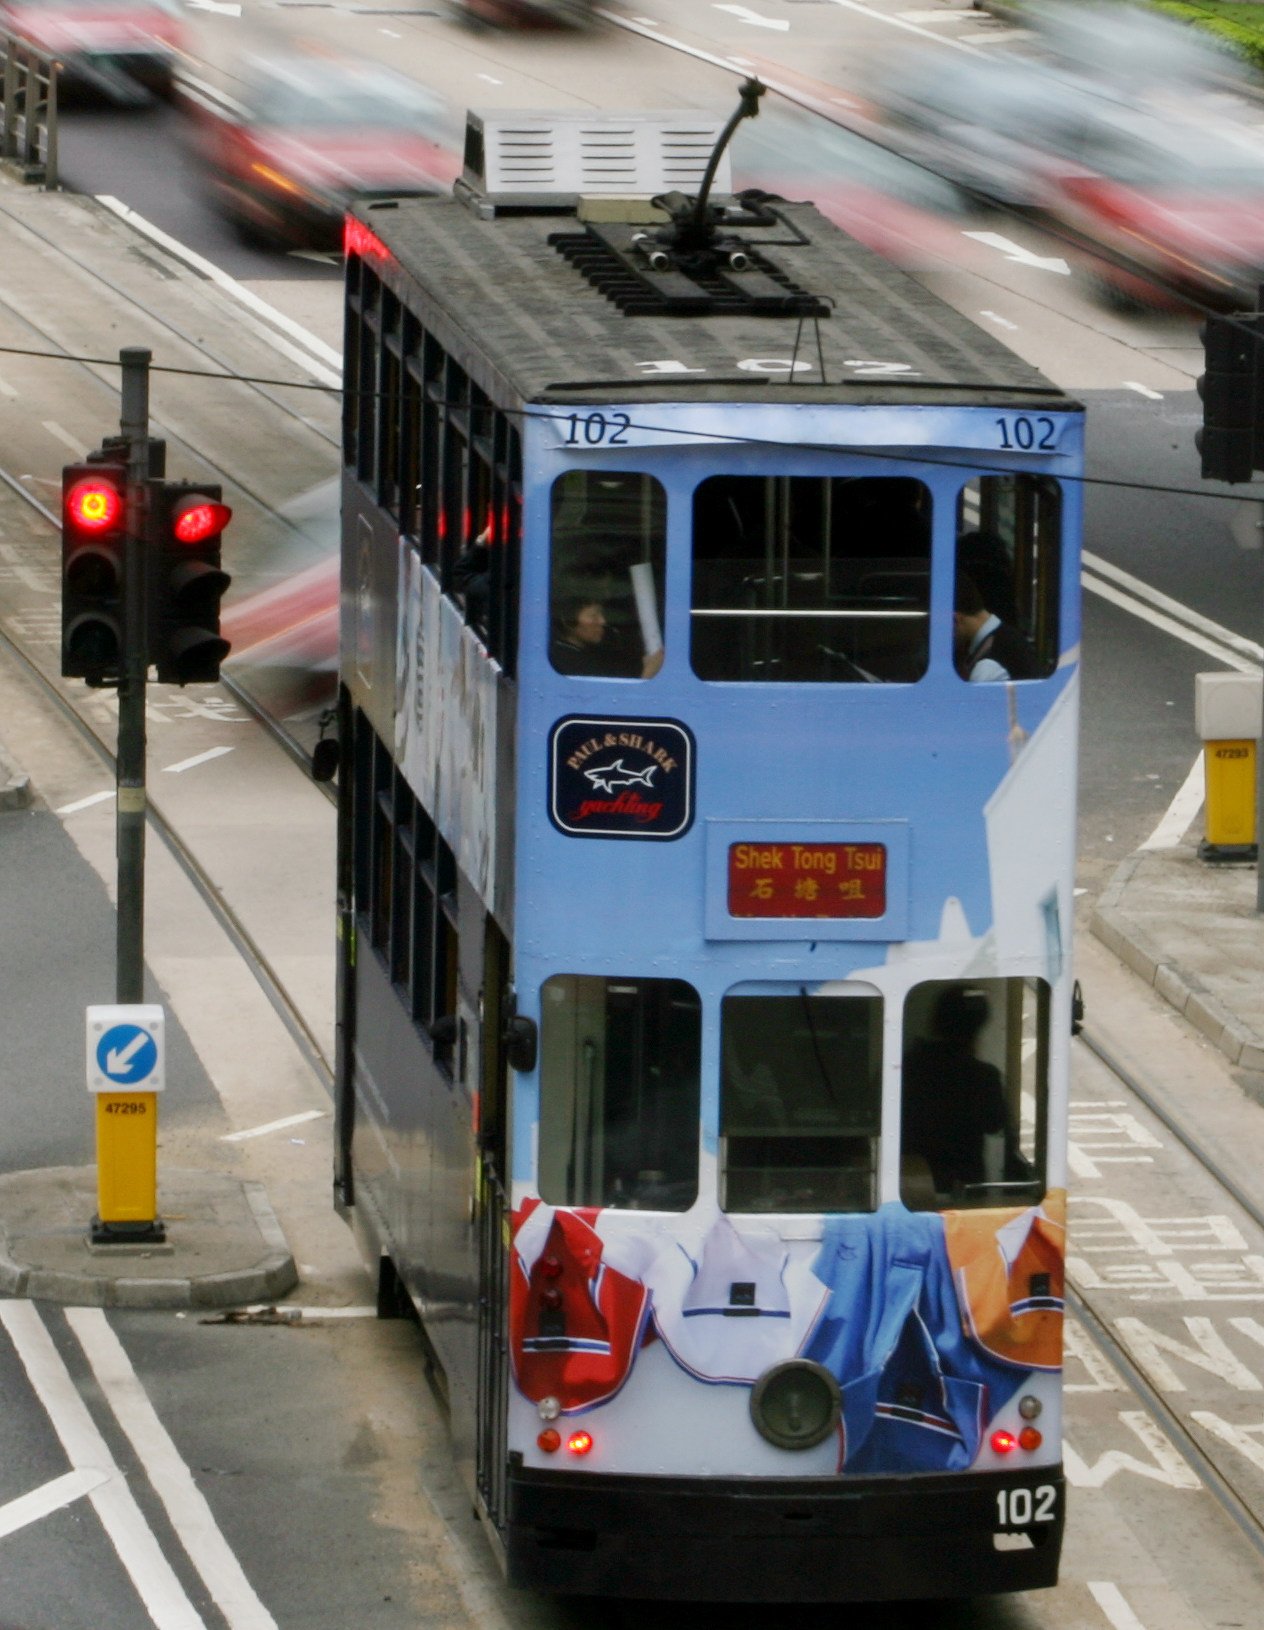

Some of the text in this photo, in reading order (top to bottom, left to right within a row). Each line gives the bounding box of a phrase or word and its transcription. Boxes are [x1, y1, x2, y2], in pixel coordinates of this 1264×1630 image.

[635, 357, 922, 376] 102
[564, 412, 631, 445] 102
[995, 416, 1057, 450] 102
[566, 738, 603, 770] PAUL
[618, 733, 678, 773] SHARK
[734, 845, 883, 874] Shek Tong Tsui
[996, 1484, 1057, 1525] 102
